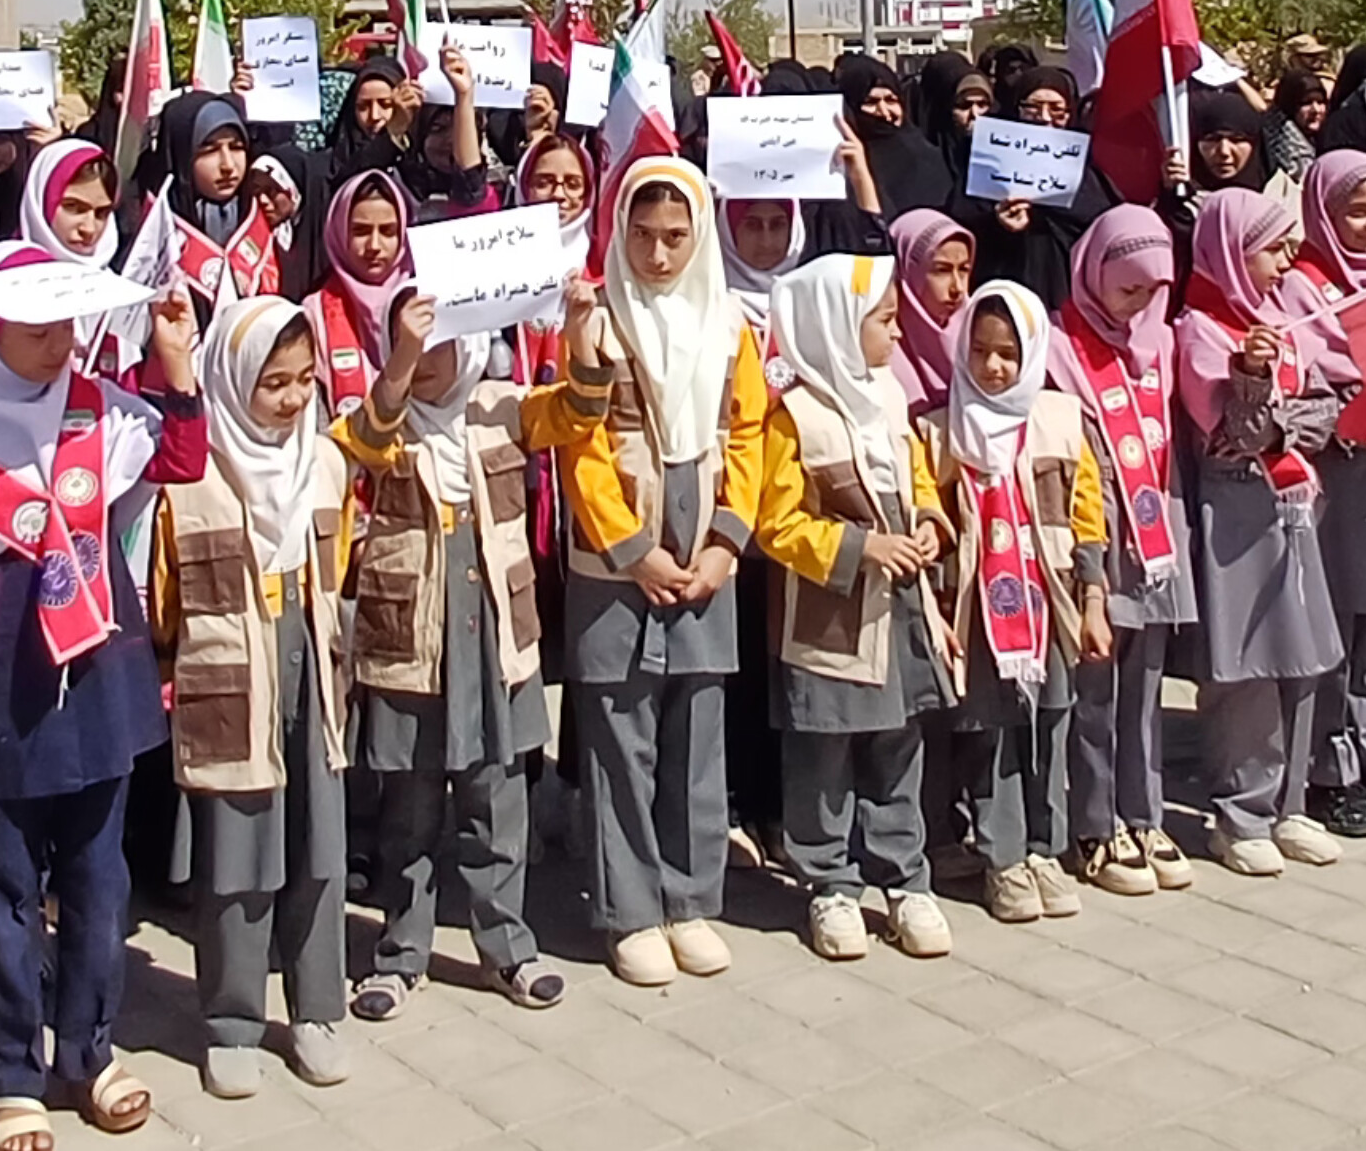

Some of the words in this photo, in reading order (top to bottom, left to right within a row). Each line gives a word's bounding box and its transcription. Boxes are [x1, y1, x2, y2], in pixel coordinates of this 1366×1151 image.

[989, 132, 1011, 147] شما
[1014, 138, 1051, 156] همراه
[1037, 174, 1067, 192] سلاح
[471, 228, 503, 251] امروز
[506, 225, 535, 246] سلاح
[494, 282, 529, 301] همراه
